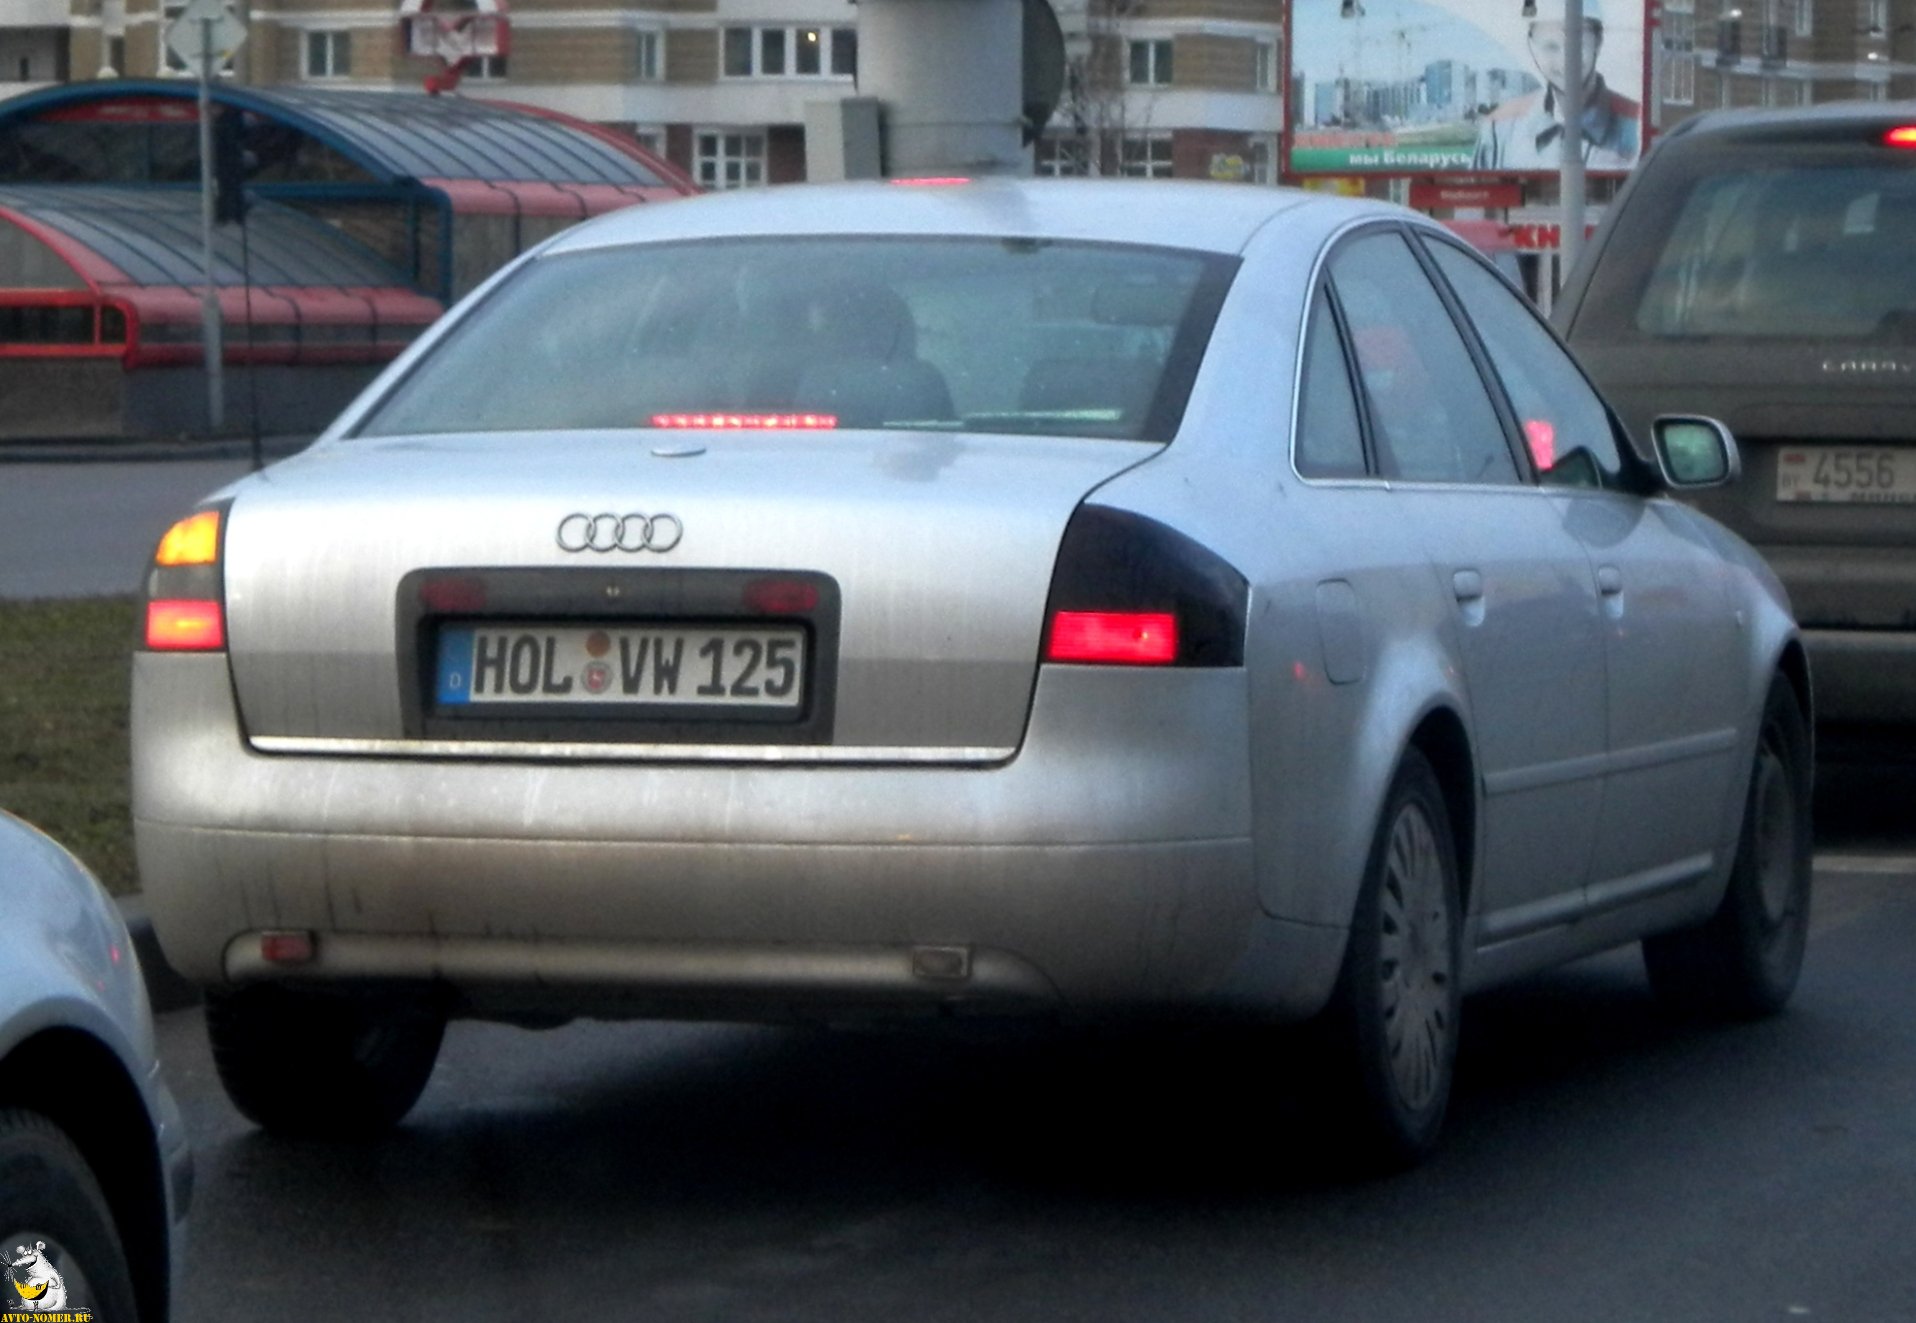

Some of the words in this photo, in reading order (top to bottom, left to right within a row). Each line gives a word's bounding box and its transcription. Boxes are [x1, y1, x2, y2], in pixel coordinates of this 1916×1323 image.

[1813, 452, 1896, 489] 4556
[474, 634, 573, 695] HOL
[619, 636, 684, 695] VW
[697, 637, 797, 697] 125
